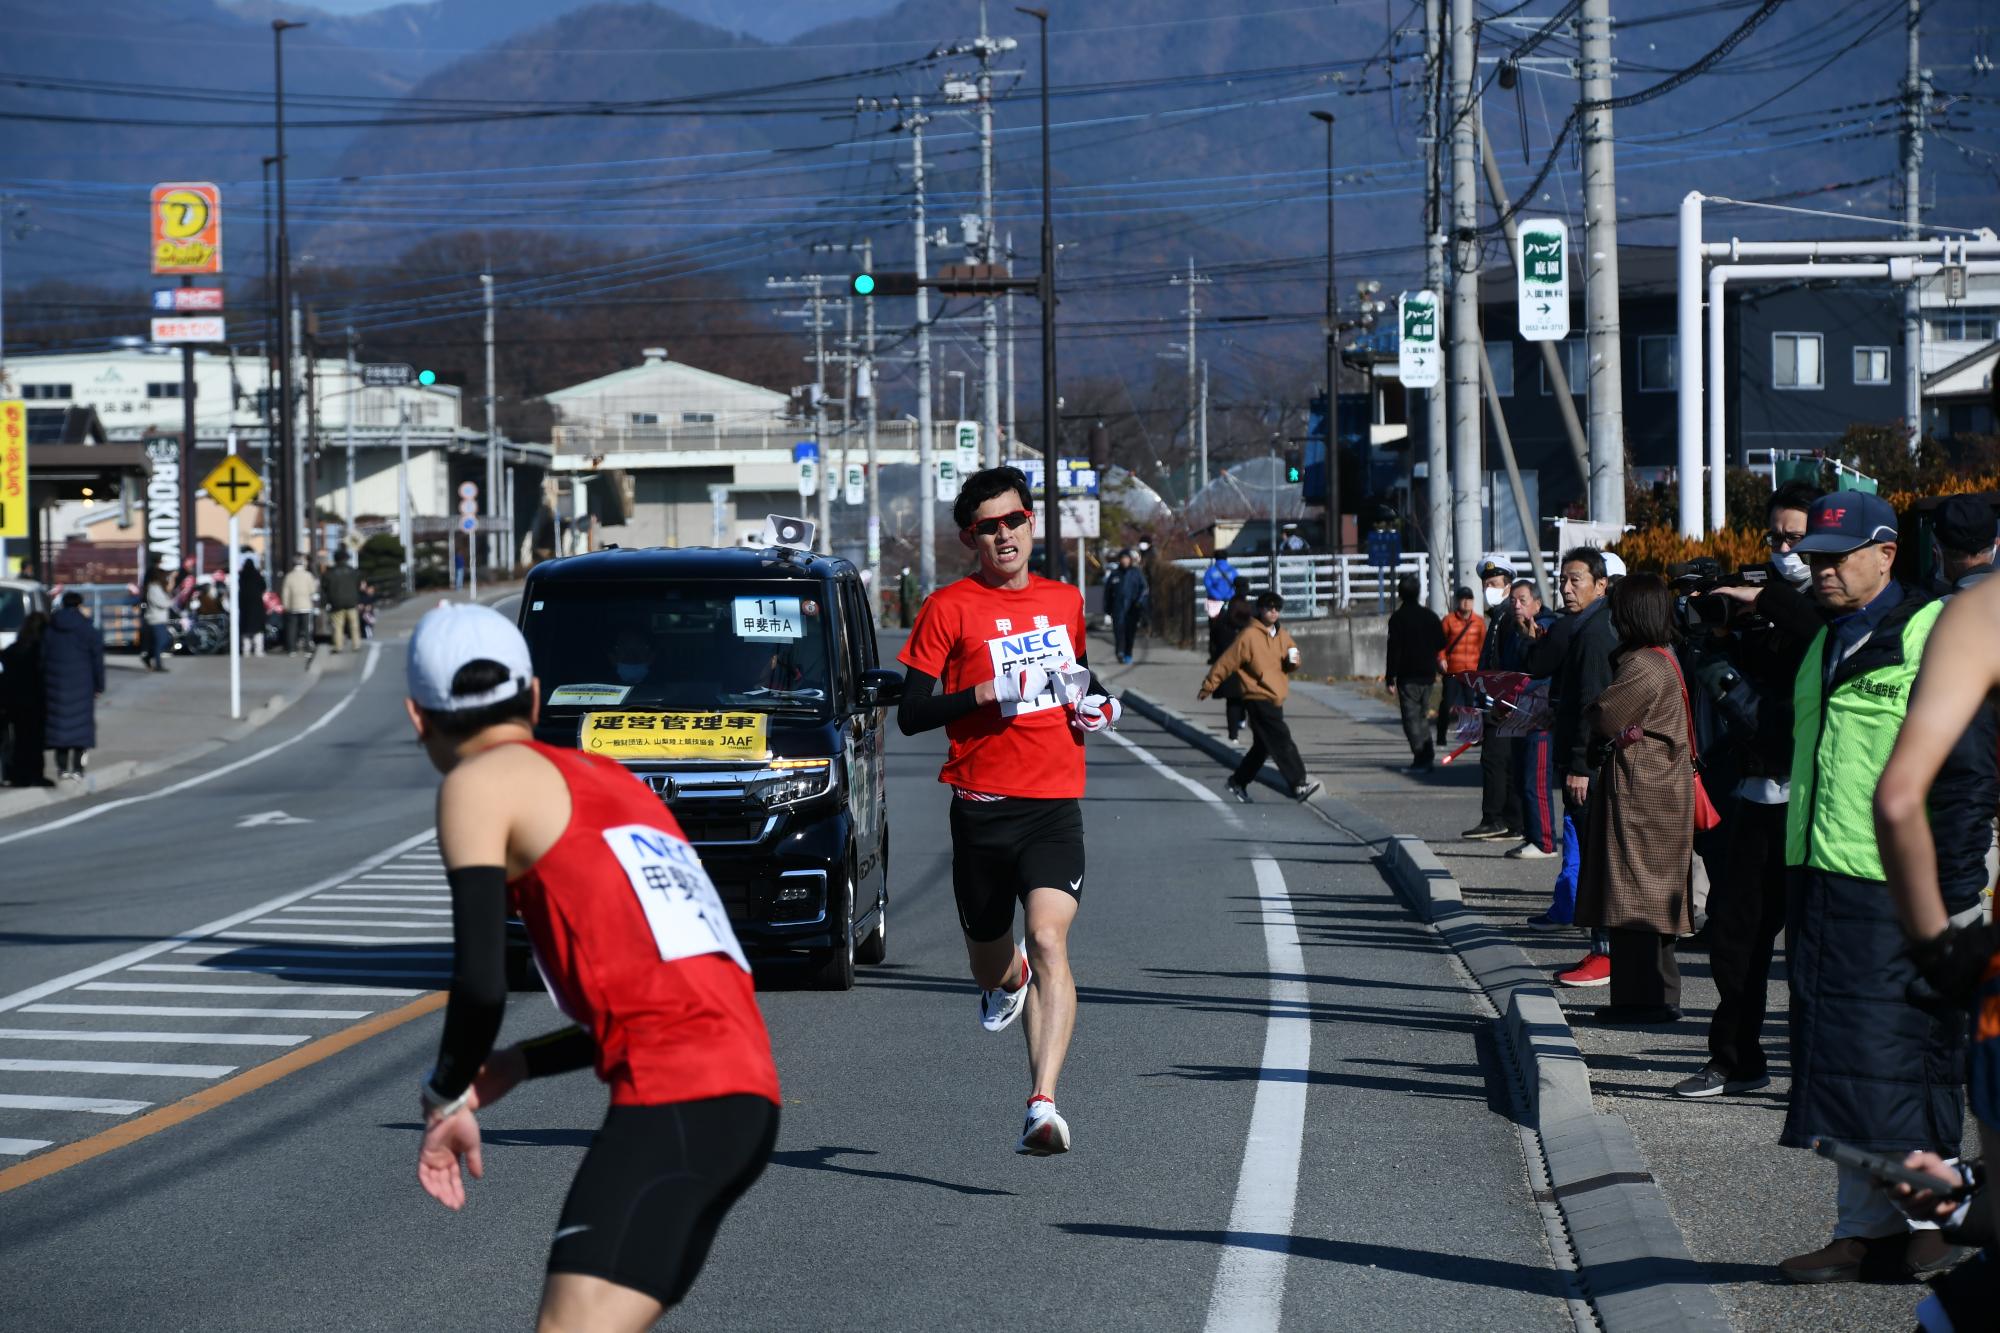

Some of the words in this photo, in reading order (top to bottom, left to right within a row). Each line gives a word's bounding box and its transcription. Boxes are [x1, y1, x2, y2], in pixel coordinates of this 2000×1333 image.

[1525, 289, 1563, 298] 入園無料
[755, 600, 777, 615] 11
[744, 618, 793, 632] 甲斐市A
[1001, 630, 1060, 658] NEC
[593, 714, 756, 731] 運営管理車
[653, 737, 715, 747] 山梨陸上競技協会
[719, 735, 754, 747] JAAF
